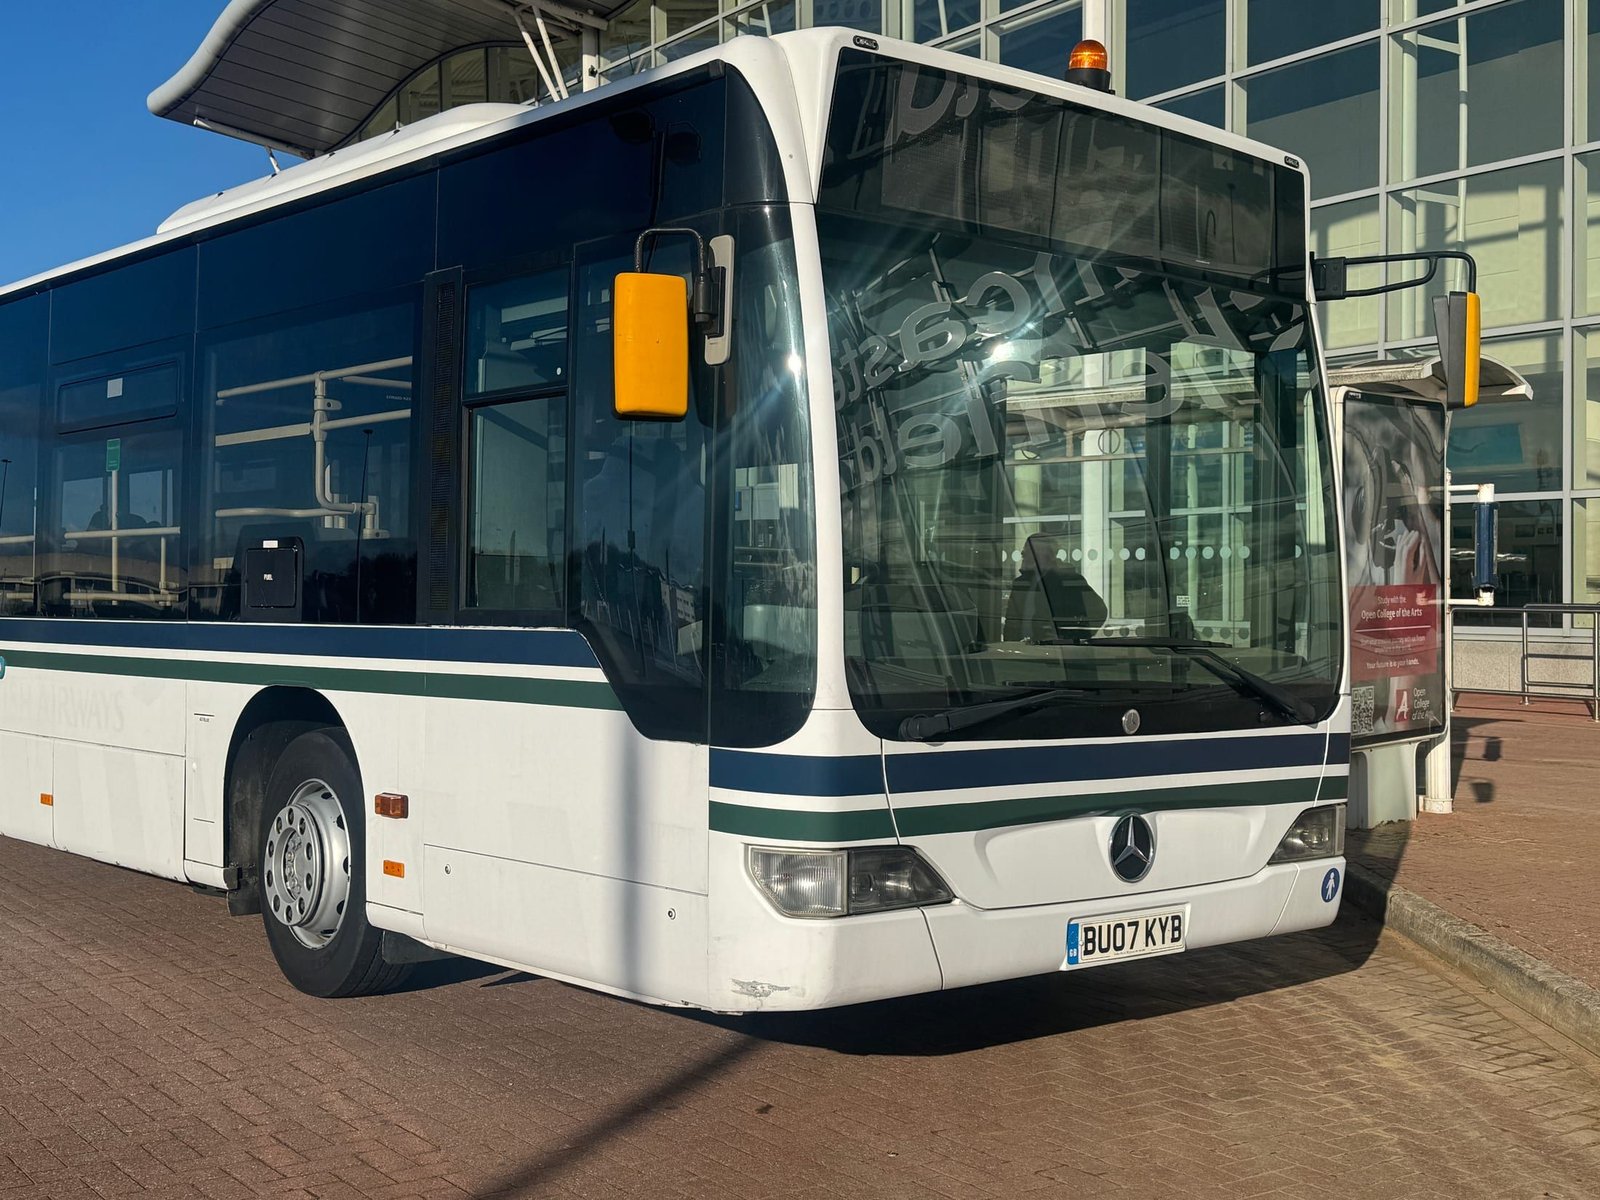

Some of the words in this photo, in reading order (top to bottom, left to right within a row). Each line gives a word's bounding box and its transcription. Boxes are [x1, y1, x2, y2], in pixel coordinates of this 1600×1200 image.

[1377, 596, 1390, 606] Study
[1390, 595, 1399, 604] with
[1399, 594, 1407, 603] the
[1361, 610, 1376, 621] Open
[1377, 609, 1396, 620] College
[1396, 607, 1401, 617] of
[1401, 607, 1410, 617] the
[1410, 607, 1423, 616] Arts
[1413, 687, 1426, 698] Open
[1413, 699, 1430, 710] College
[1083, 920, 1139, 956] BU07
[1145, 914, 1182, 947] KYB
